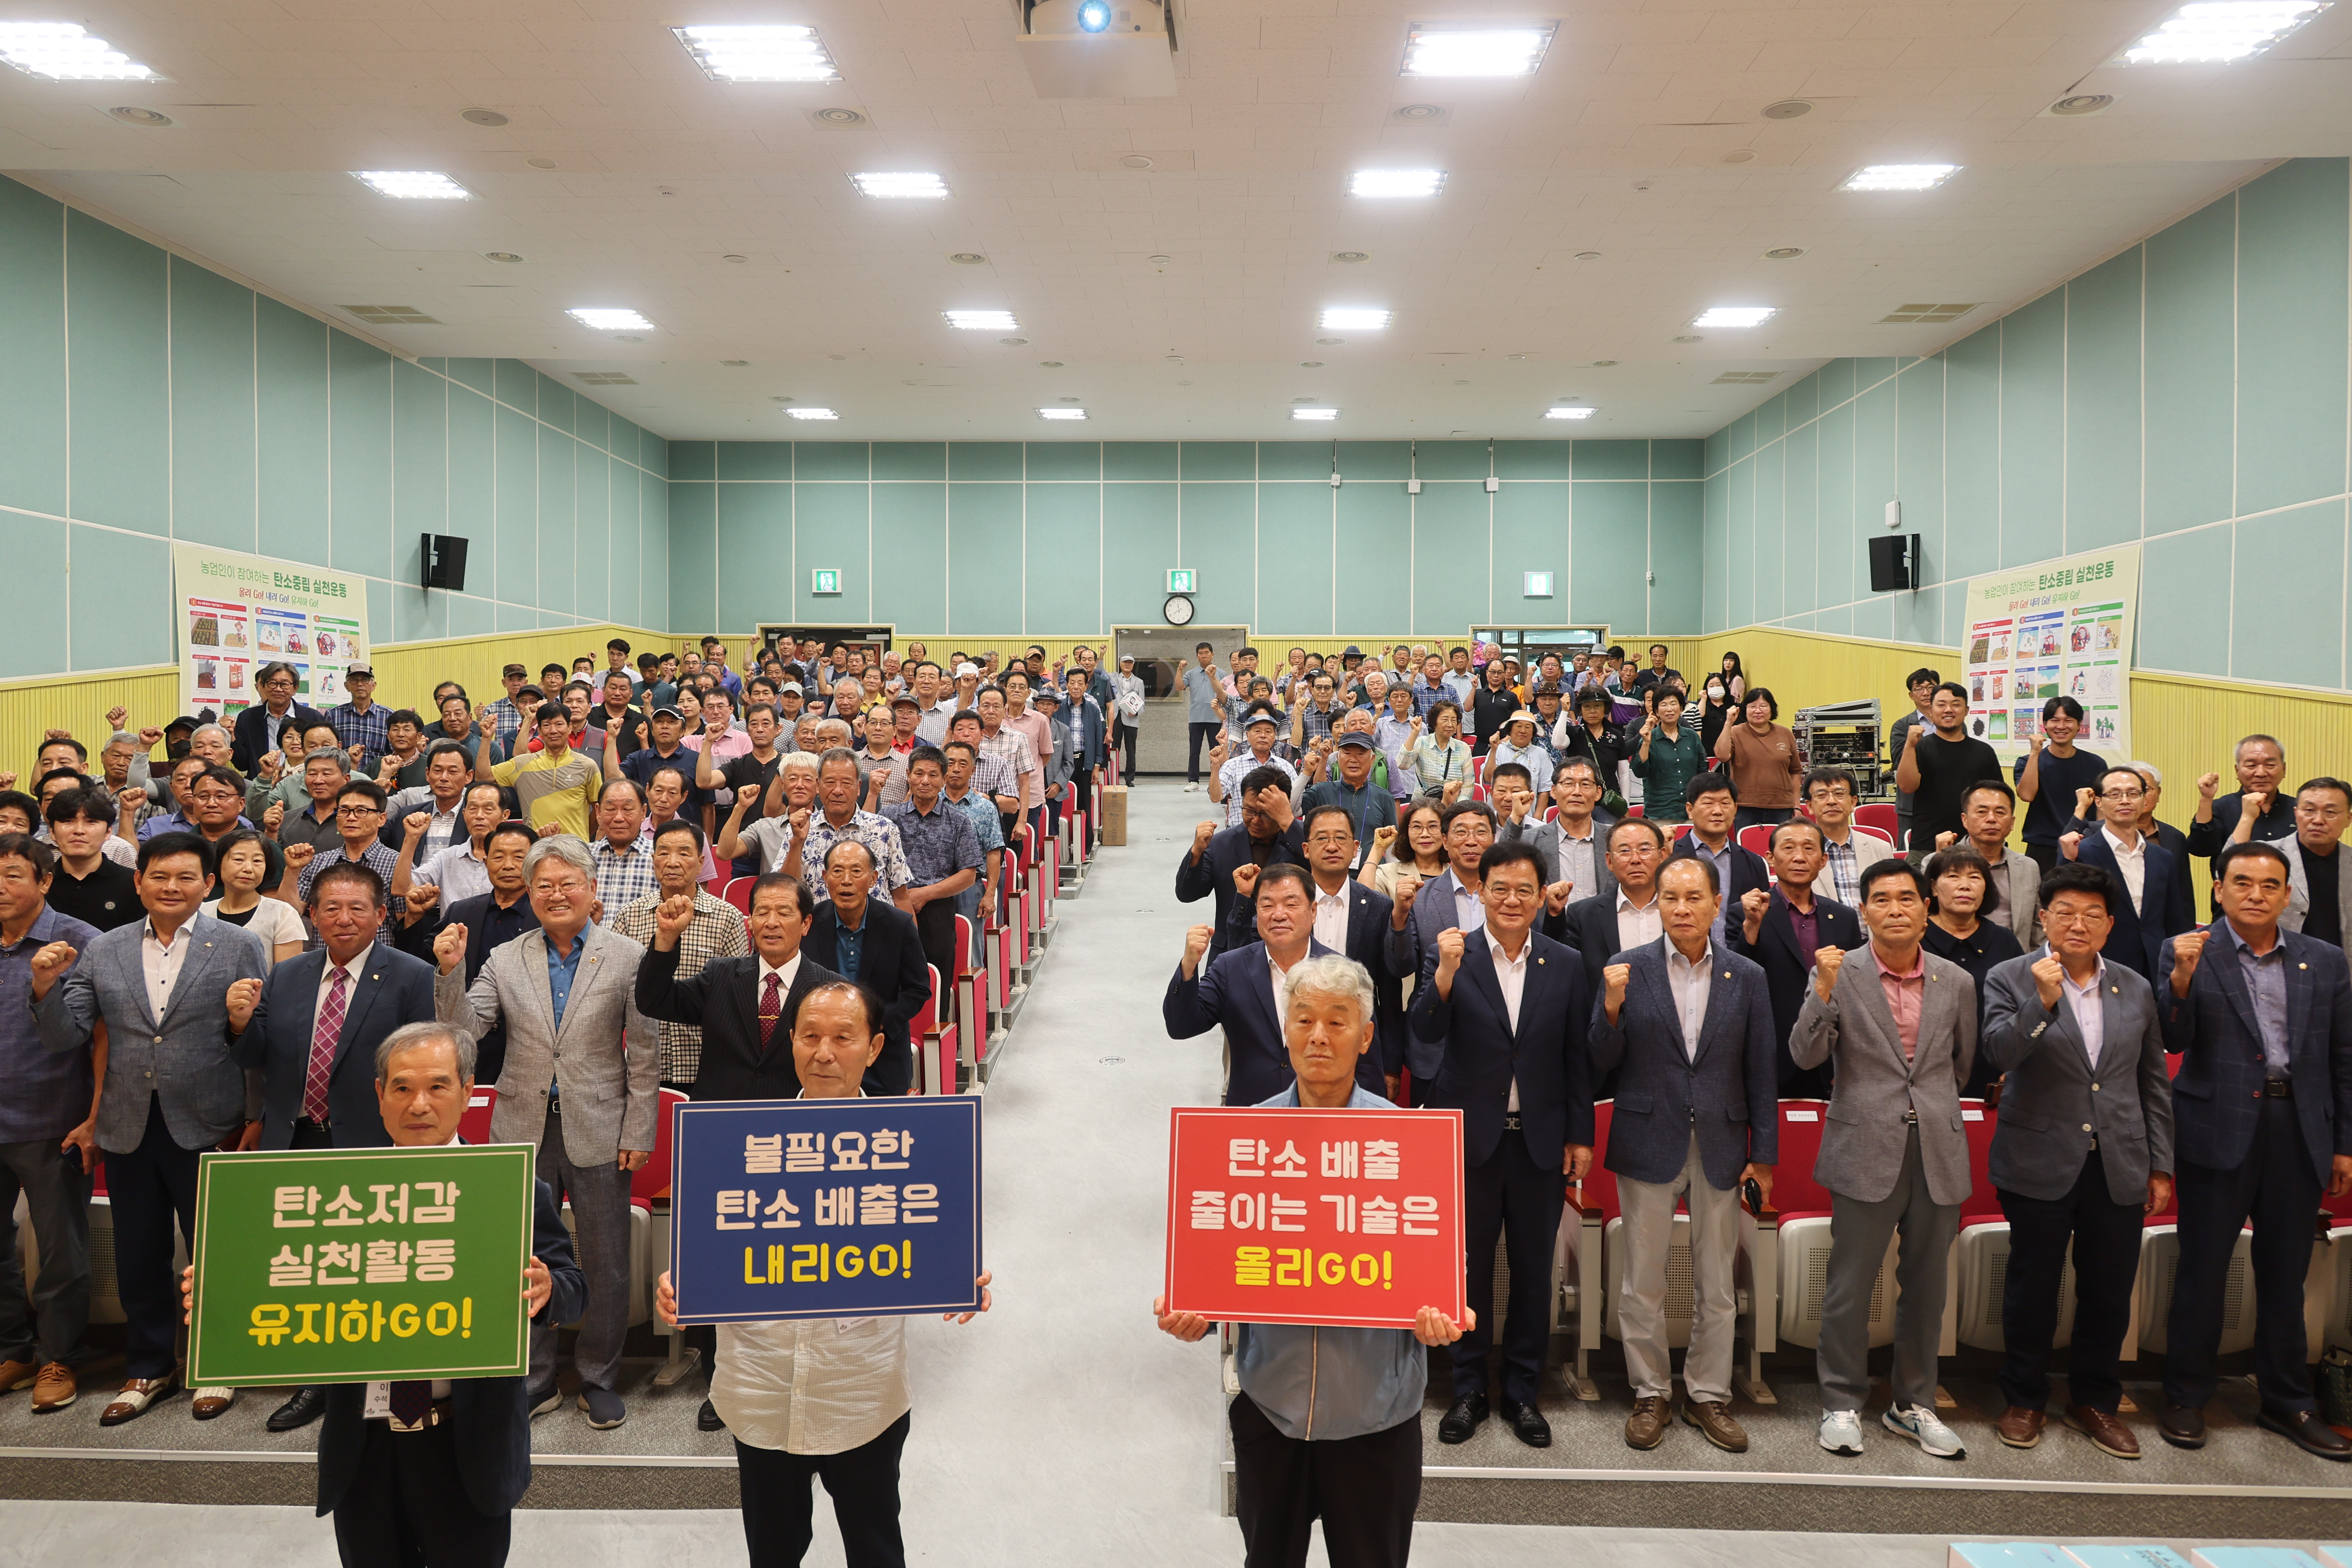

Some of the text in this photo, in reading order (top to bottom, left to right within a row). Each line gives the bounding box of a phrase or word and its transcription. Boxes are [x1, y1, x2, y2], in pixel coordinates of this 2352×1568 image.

[201, 560, 347, 598] 농업인이 참여하는 탄소중립 실천운동
[239, 587, 319, 608] 올리 Go! 내리 Go! 유지하 Go!
[1984, 560, 2114, 599] 농업인이 참여하는 탄소중립 실천운동
[2009, 590, 2081, 612] 올리 Go! 내리 Go! 유지하 Go!
[744, 1128, 915, 1174] 불필요한
[1229, 1138, 1401, 1180] 탄소 배출
[273, 1181, 461, 1228] 탄소저감
[716, 1183, 940, 1230] 탄소 배출은
[1190, 1191, 1440, 1236] 줄이는 기술은
[269, 1239, 456, 1287] 실천활동
[744, 1240, 911, 1285] 내리GO!
[1234, 1246, 1392, 1290] 올리GO!
[248, 1297, 472, 1346] 유지하GO!
[380, 1383, 391, 1392] 이
